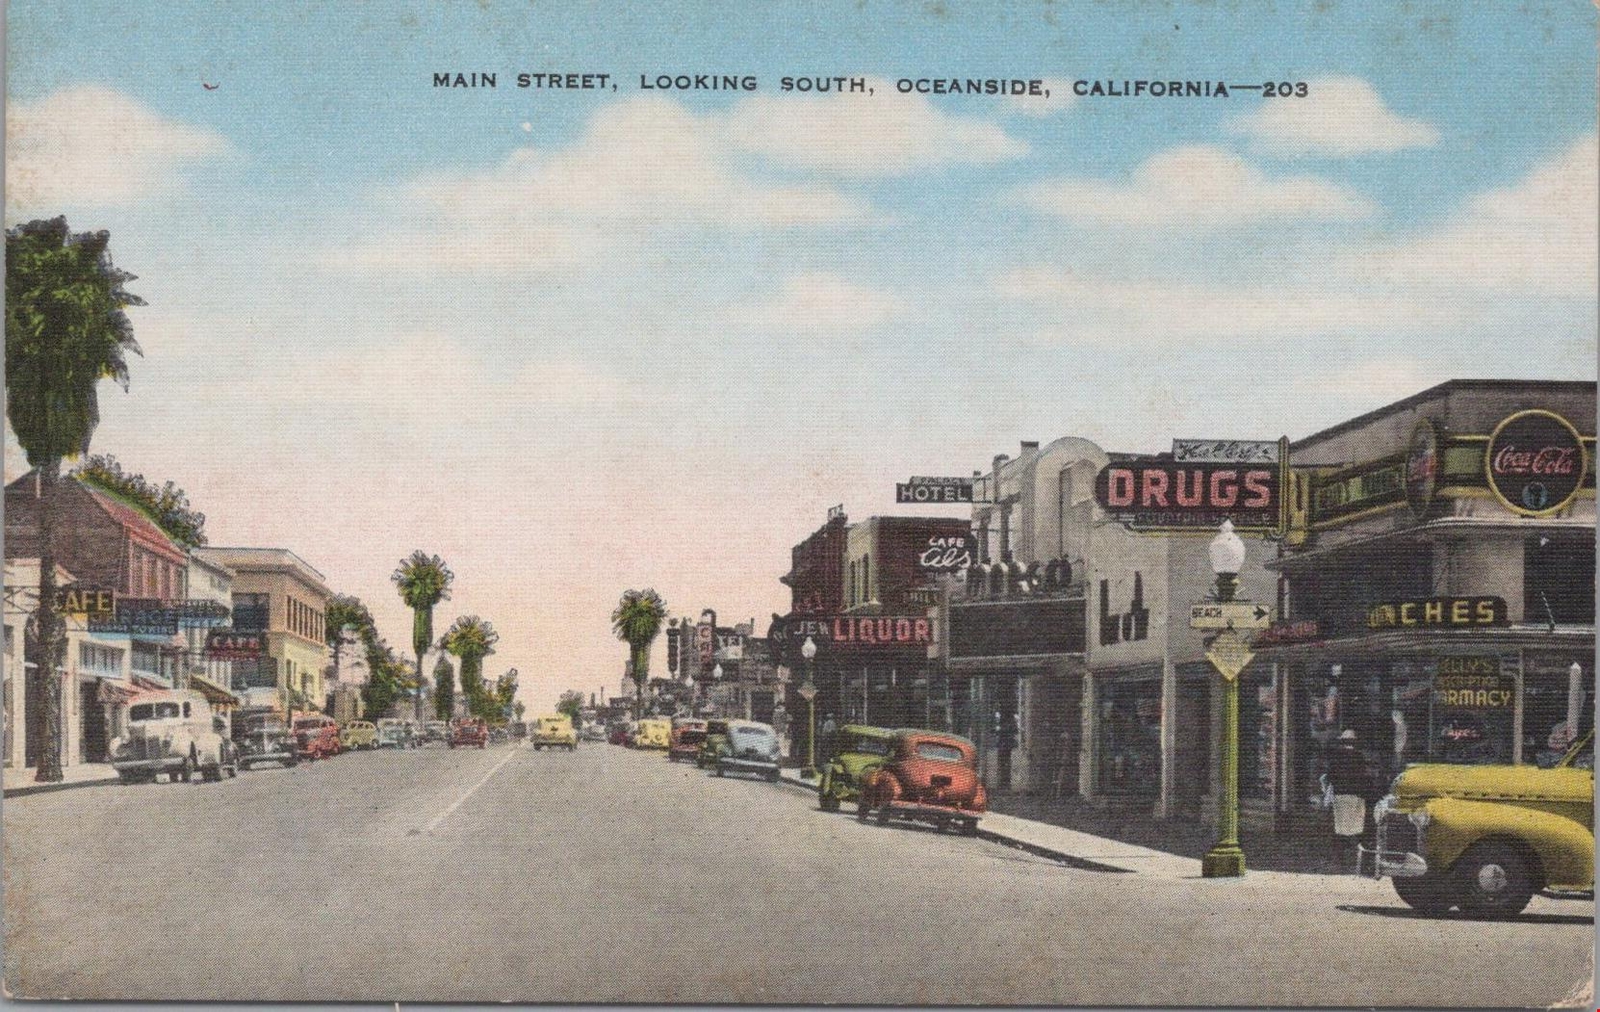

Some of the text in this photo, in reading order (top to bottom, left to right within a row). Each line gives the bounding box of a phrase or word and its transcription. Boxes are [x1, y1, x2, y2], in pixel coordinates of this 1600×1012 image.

[900, 485, 968, 501] HOTEL
[1108, 468, 1272, 508] DRUGS
[929, 537, 965, 548] CAFE
[1191, 607, 1223, 618] BEACH
[833, 616, 931, 643] LIQUOR
